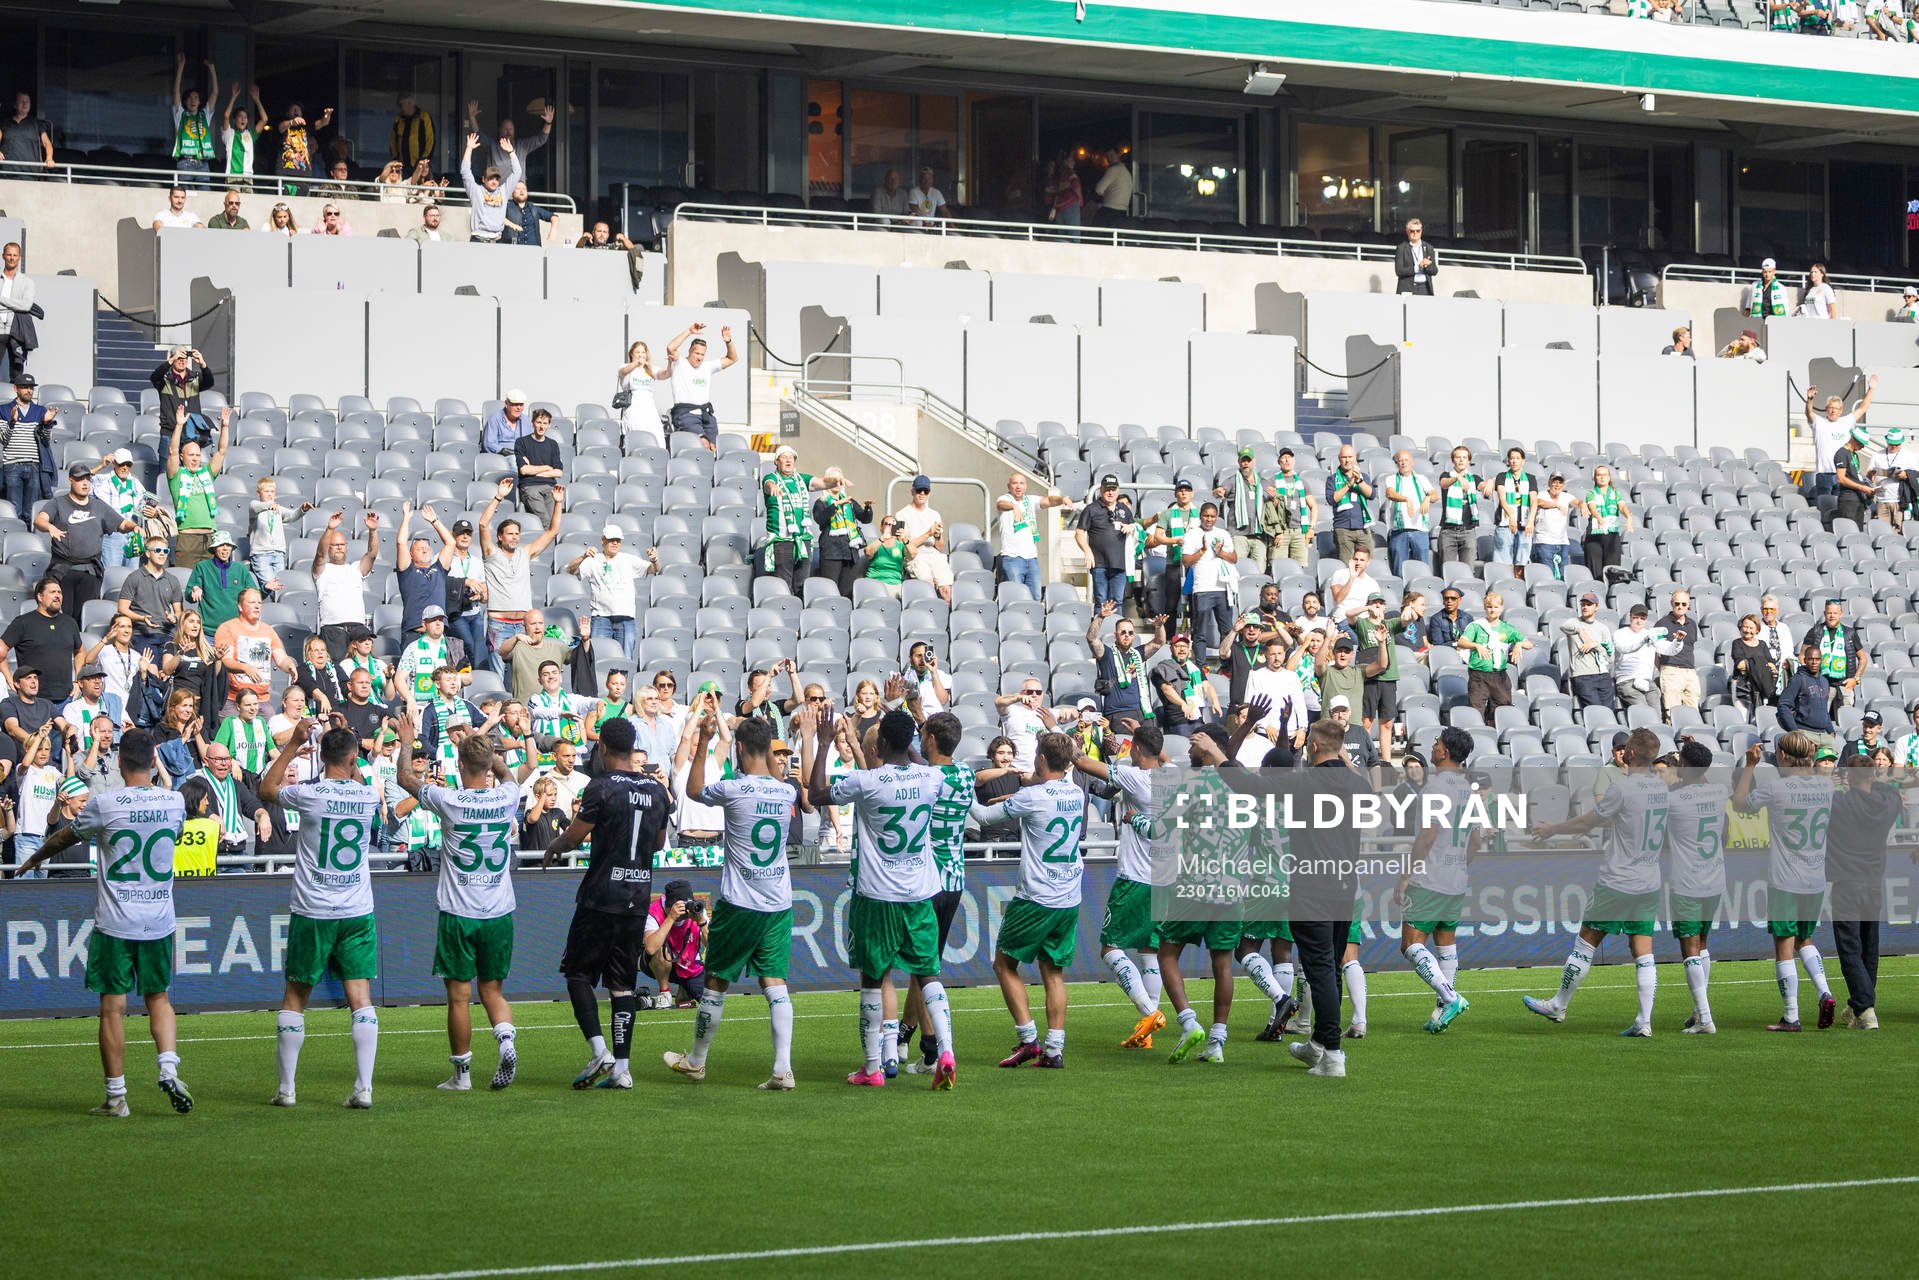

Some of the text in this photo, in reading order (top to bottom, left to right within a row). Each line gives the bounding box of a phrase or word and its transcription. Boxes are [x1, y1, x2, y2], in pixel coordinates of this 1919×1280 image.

[326, 799, 364, 814] SADIKU
[462, 806, 506, 820] HAMMAR
[895, 787, 921, 801] ADJEI
[1695, 801, 1716, 814] TEKIE
[1790, 792, 1831, 804] KARLSSON
[129, 810, 169, 823] BESARA
[630, 809, 643, 861] 1
[877, 803, 931, 855] 32
[1640, 807, 1668, 852] 13
[1696, 816, 1719, 860] 5
[1781, 807, 1831, 850] 36
[106, 828, 177, 882] 20
[317, 816, 364, 872] 18
[452, 822, 511, 873] 33
[750, 817, 782, 868] 9
[1041, 815, 1083, 863] 22
[325, 873, 361, 885] PROJOB
[752, 867, 785, 878] PROJOB
[131, 889, 170, 900] PROJOB
